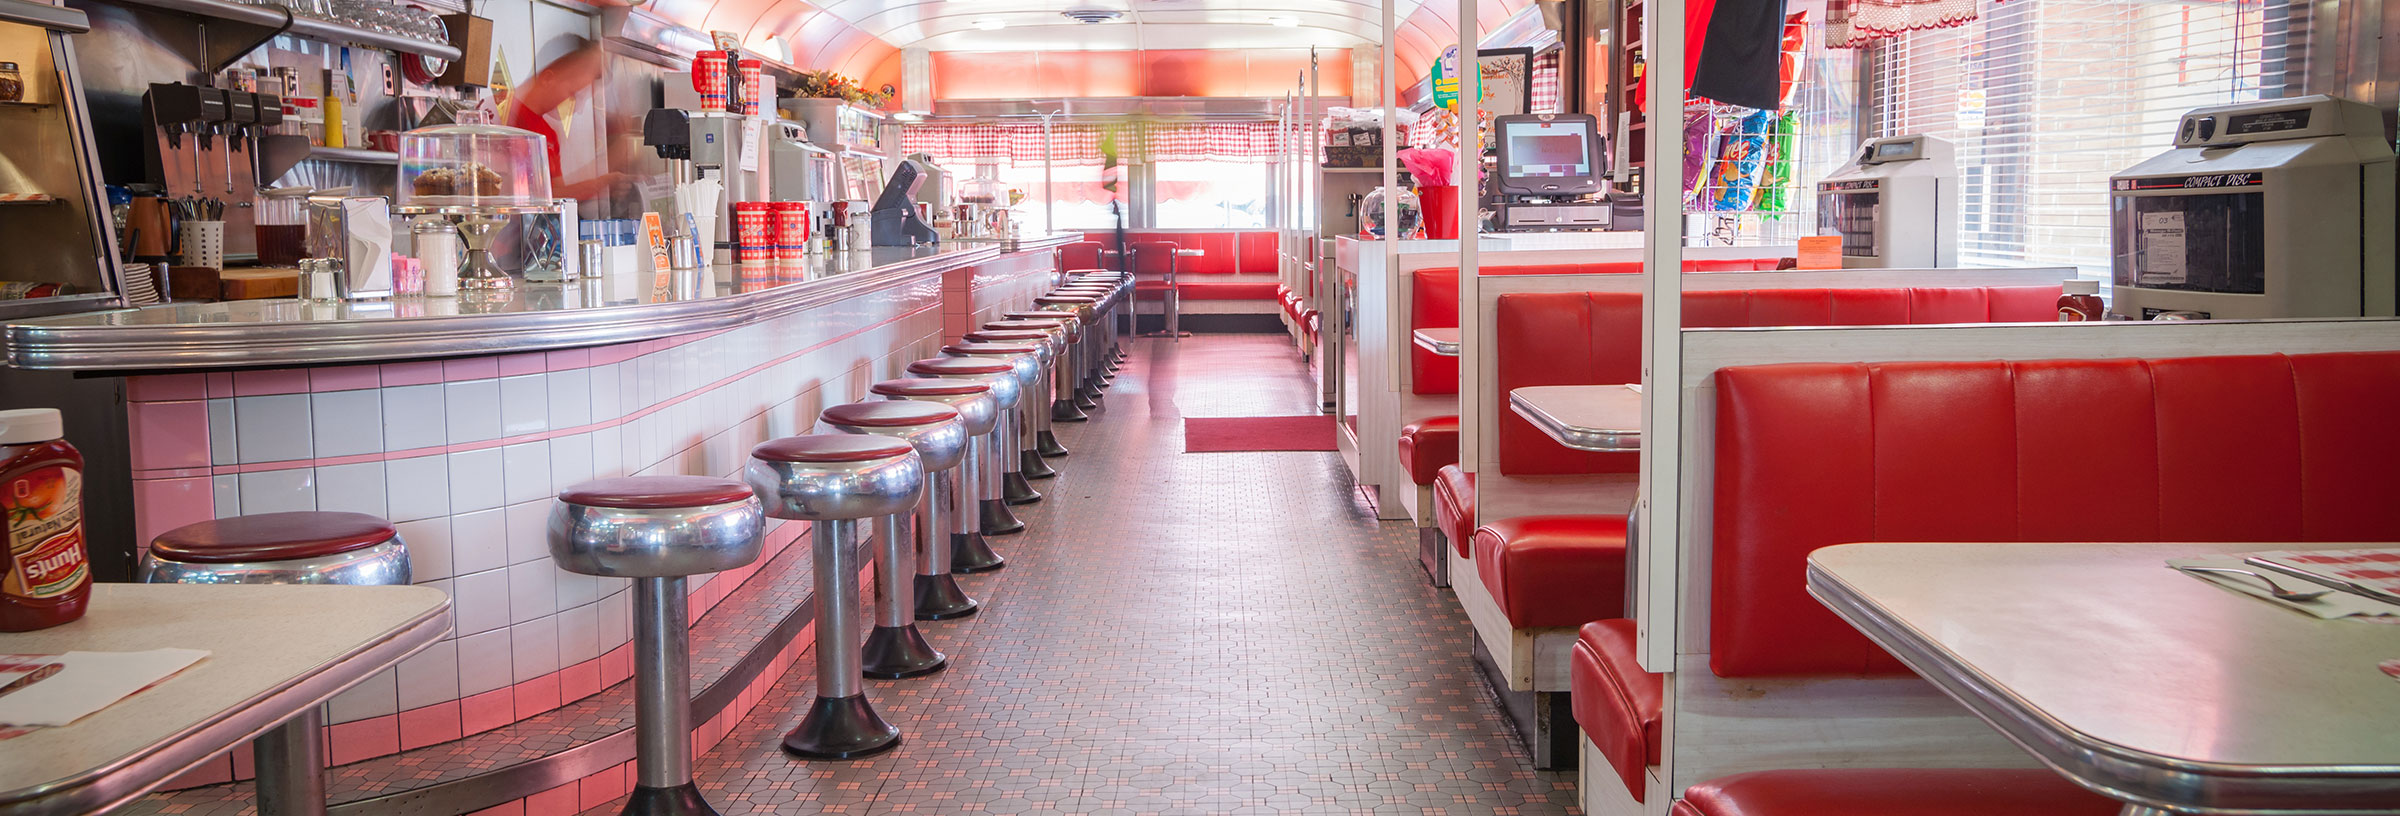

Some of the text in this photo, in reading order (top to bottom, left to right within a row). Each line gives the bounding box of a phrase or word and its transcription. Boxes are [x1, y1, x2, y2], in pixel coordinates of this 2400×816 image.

[2184, 173, 2251, 188] COMPACT DISC
[17, 519, 61, 543] Natural
